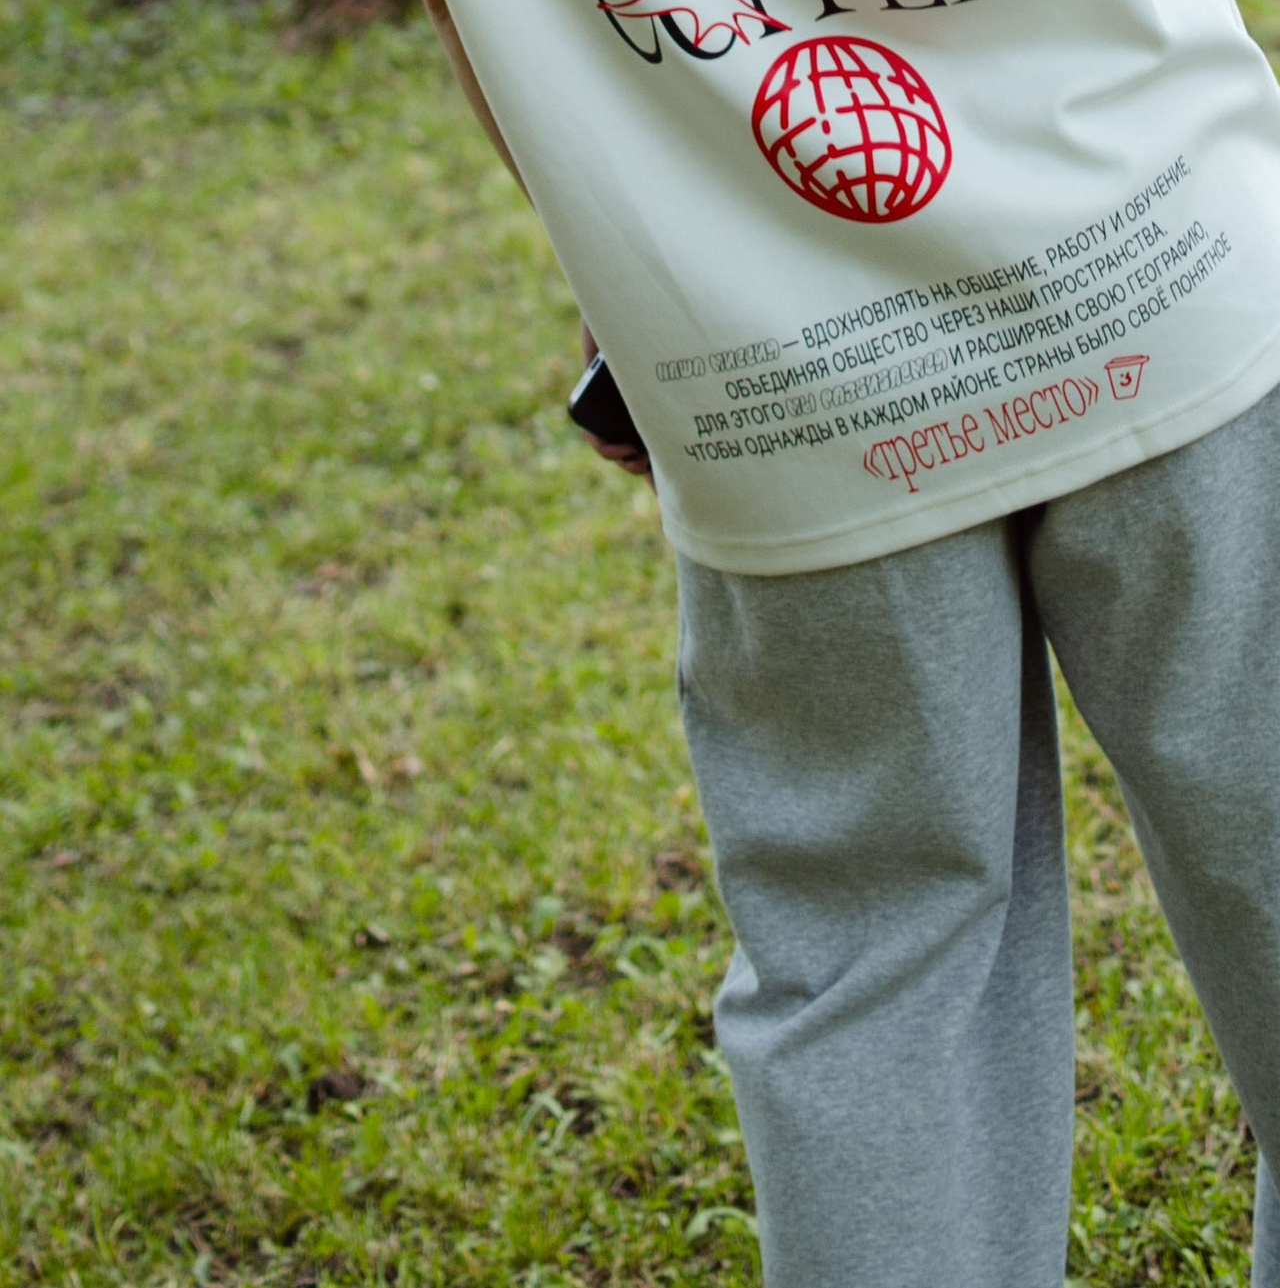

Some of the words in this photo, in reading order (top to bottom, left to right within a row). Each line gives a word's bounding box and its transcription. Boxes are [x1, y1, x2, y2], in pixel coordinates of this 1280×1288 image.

[685, 437, 742, 463] ЧТОБЫ
[744, 419, 834, 457] ОДНАЖДЫ
[837, 414, 850, 436] В
[850, 395, 929, 434] КАЖДОМ
[933, 366, 1002, 408] РАЙОНЕ
[1003, 349, 1075, 385] СТРАНЫ
[1079, 317, 1126, 357] БЫЛО
[1127, 285, 1171, 330] СВОЁ
[1169, 231, 1232, 305] ПОНЯТНОЕ
[694, 414, 727, 438] ДЛЯ
[730, 401, 785, 430] ЭТОГО
[948, 345, 965, 367] И
[966, 310, 1074, 360] РАСШИРЯЕМ
[1074, 283, 1126, 322] СВОЮ
[1126, 220, 1209, 297] ГЕОГРАФИЮ,
[725, 359, 829, 402] ОБЪЕДИНЯЯ
[833, 322, 929, 372] ОБЩЕСТВО
[931, 304, 985, 336] ЧЕРЕЗ
[988, 290, 1040, 320] НАШИ
[1040, 220, 1169, 308] ПРОСТРАНСТВА.
[802, 287, 930, 351] ВДОХНОВЛЯТЬ
[931, 280, 956, 307] НА
[956, 256, 1048, 298] ОБЩЕНИЕ,
[1045, 220, 1109, 269] РАБОТУ
[1109, 211, 1126, 233] И
[1124, 155, 1192, 223] ОБУЧЕНИЕ,
